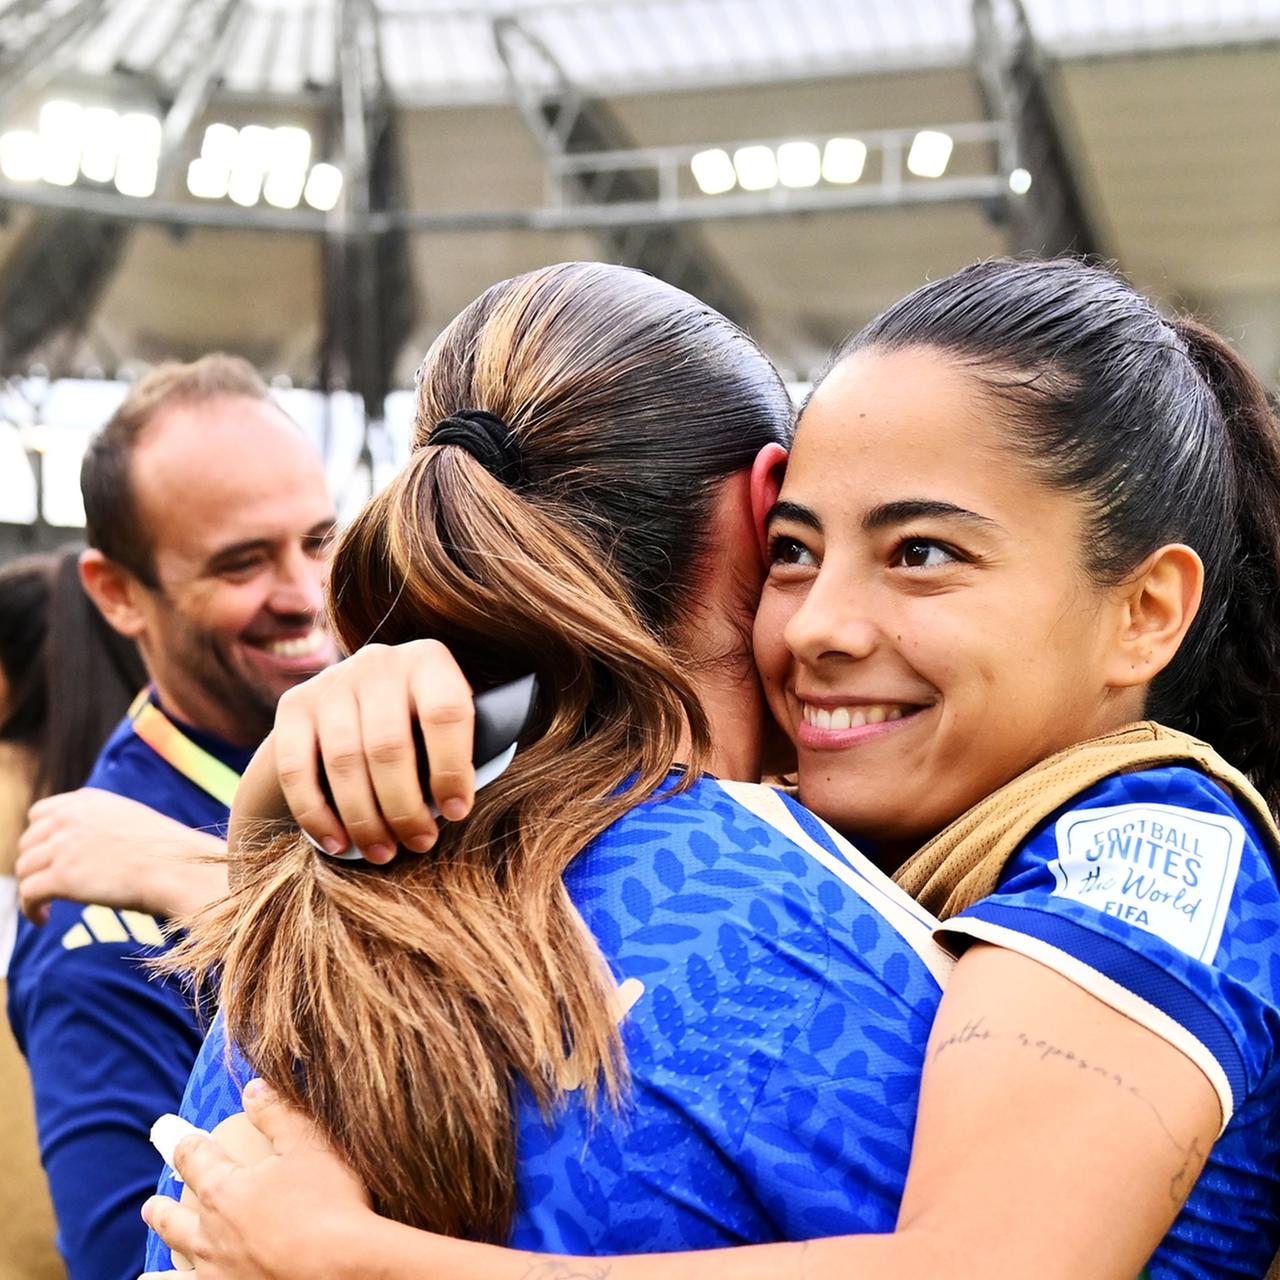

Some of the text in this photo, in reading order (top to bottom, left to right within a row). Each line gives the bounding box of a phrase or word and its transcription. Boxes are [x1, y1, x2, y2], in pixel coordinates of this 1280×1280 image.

[1086, 832, 1202, 888] UNITES
[1094, 819, 1204, 858] FOOTBALL
[1078, 866, 1202, 922] the World
[1104, 900, 1149, 926] FIFA
